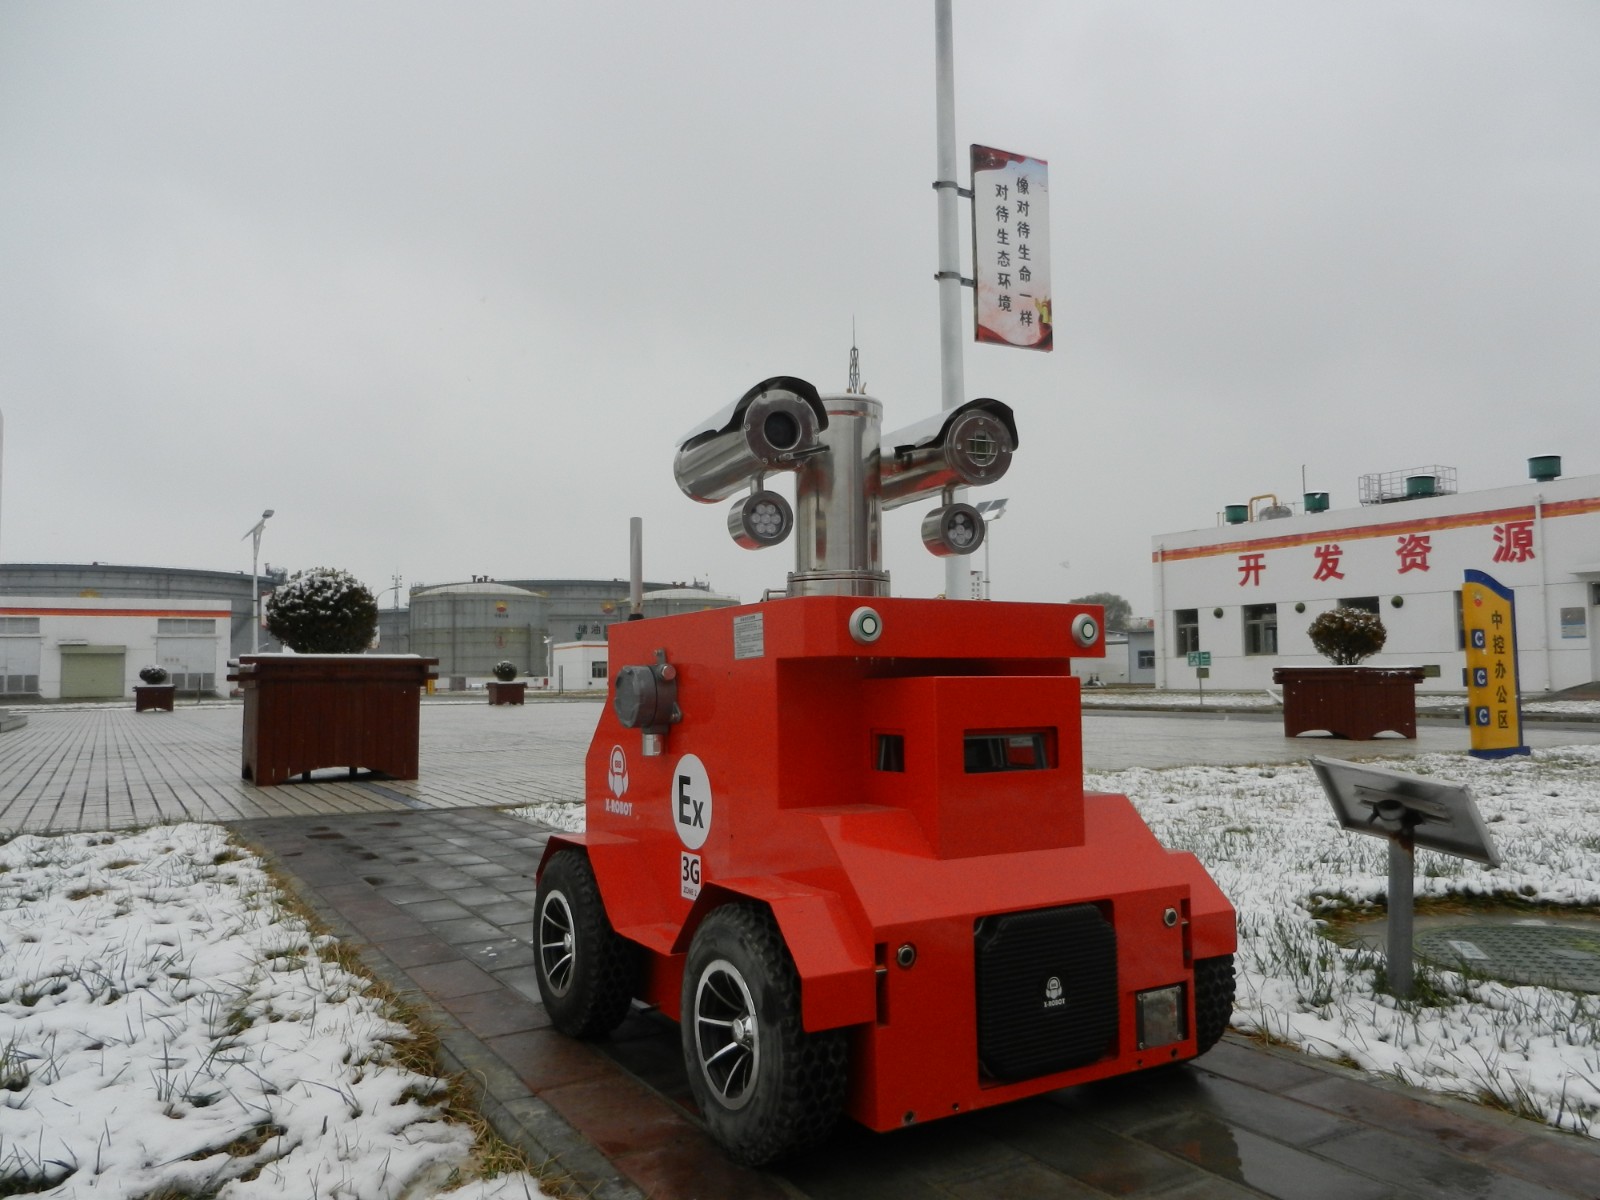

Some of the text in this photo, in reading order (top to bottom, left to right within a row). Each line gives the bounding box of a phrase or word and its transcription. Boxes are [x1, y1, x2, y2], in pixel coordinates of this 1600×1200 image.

[995, 184, 1012, 312] 对待生态环境
[1016, 177, 1033, 327] 像对待生命一样
[1238, 521, 1536, 586] 开发资源
[1491, 610, 1508, 729] 中控办公区
[682, 856, 700, 884] 3G
